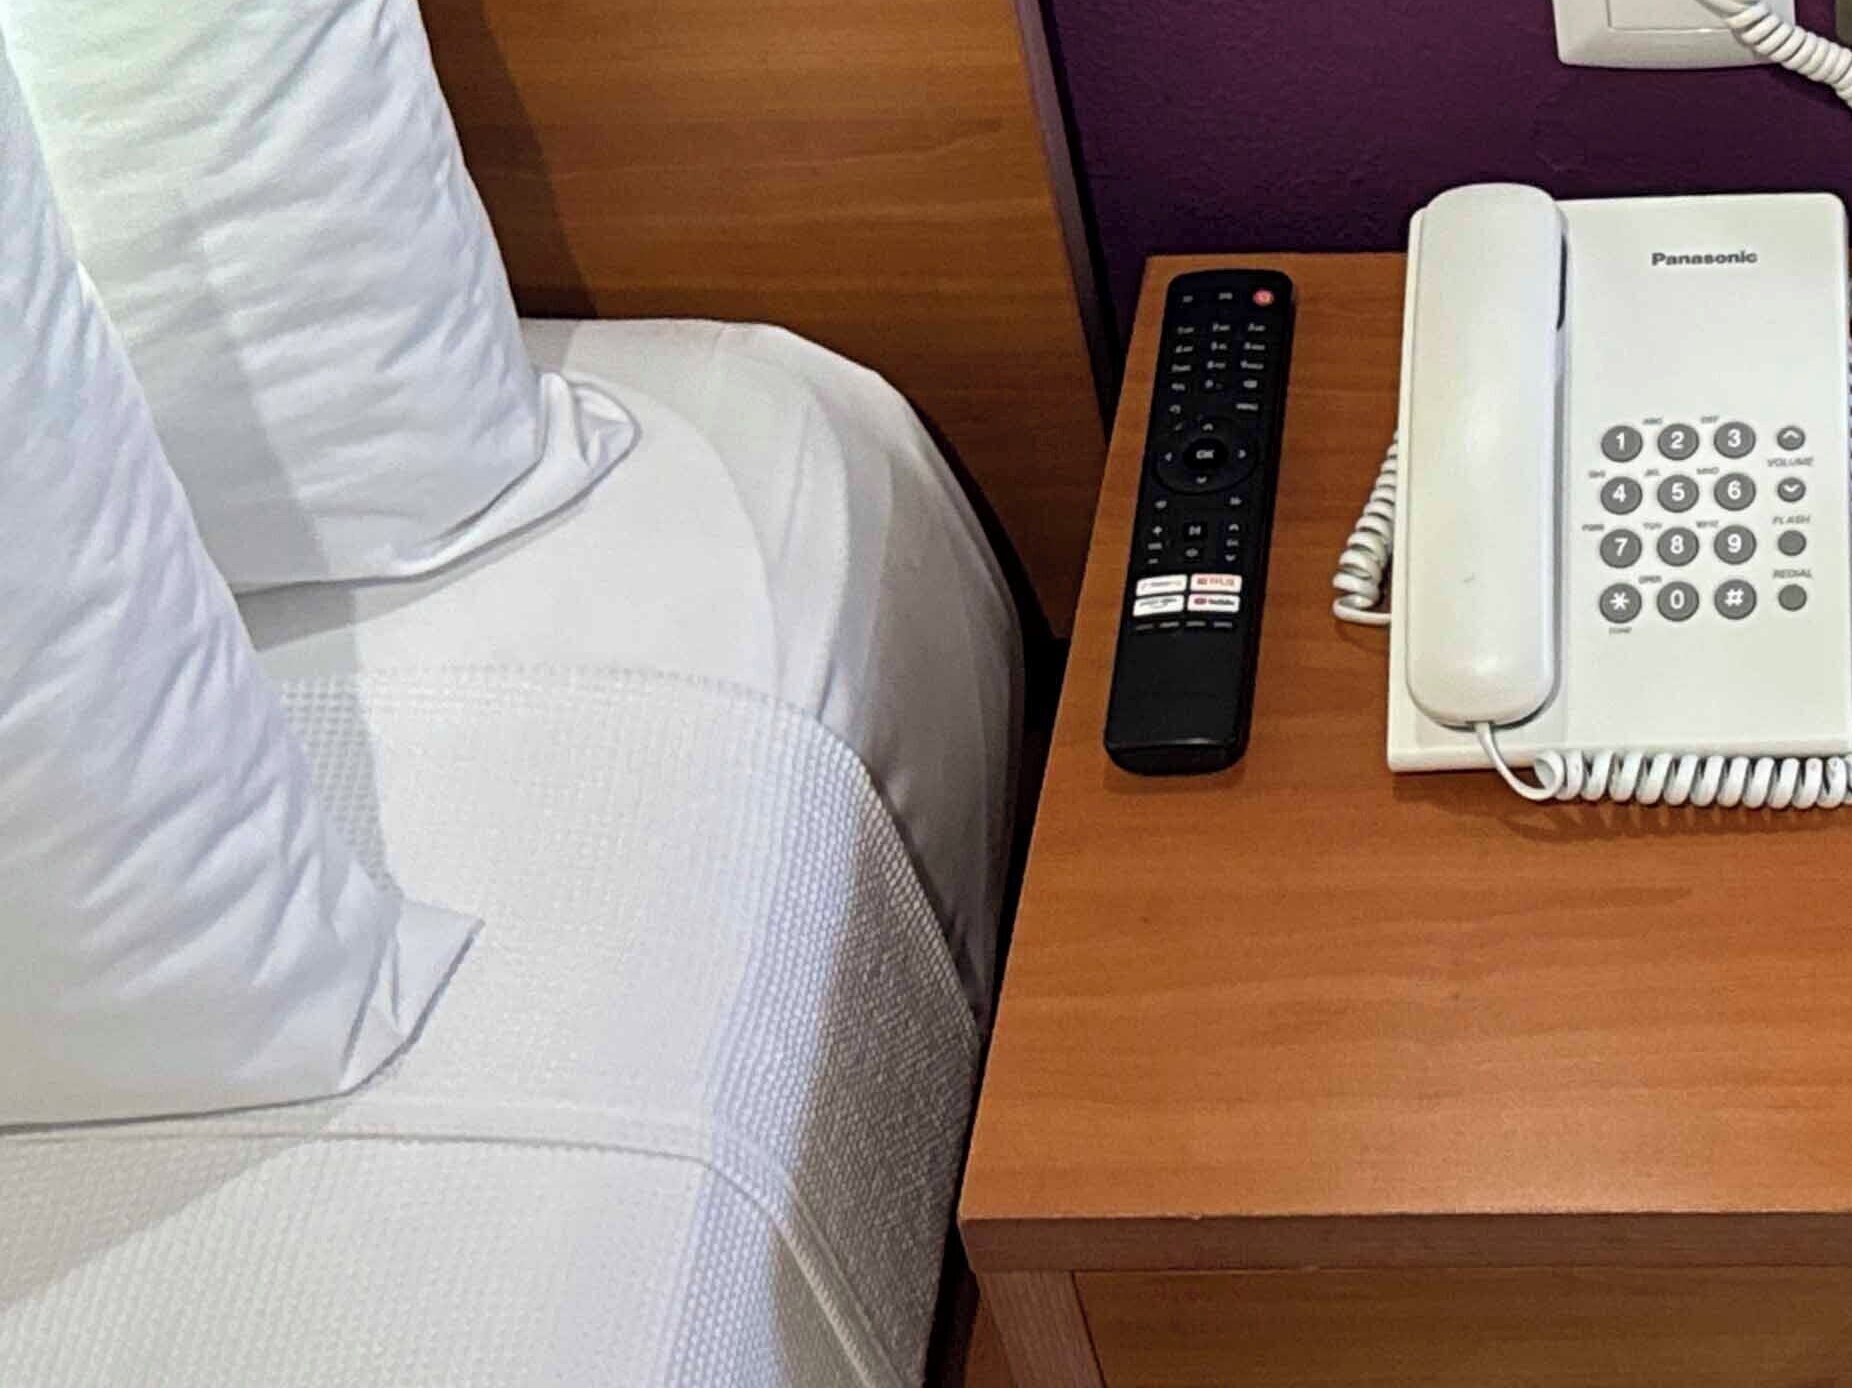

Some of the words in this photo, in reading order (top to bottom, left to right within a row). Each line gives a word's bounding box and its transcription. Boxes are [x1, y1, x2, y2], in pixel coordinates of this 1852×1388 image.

[1651, 249, 1758, 266] Panasonic
[1615, 432, 1626, 451] 1
[1670, 430, 1685, 449] 2
[1727, 429, 1742, 448] 3
[1767, 457, 1814, 468] VOLUME
[1612, 483, 1627, 502] 4
[1671, 482, 1686, 501] 5
[1727, 480, 1742, 500] 6
[1772, 514, 1811, 525] FLASH
[1614, 537, 1629, 556] 7
[1670, 534, 1685, 554] 8
[1727, 533, 1742, 553] 9
[1772, 569, 1813, 579] REDIAL
[1670, 589, 1685, 609] 0
